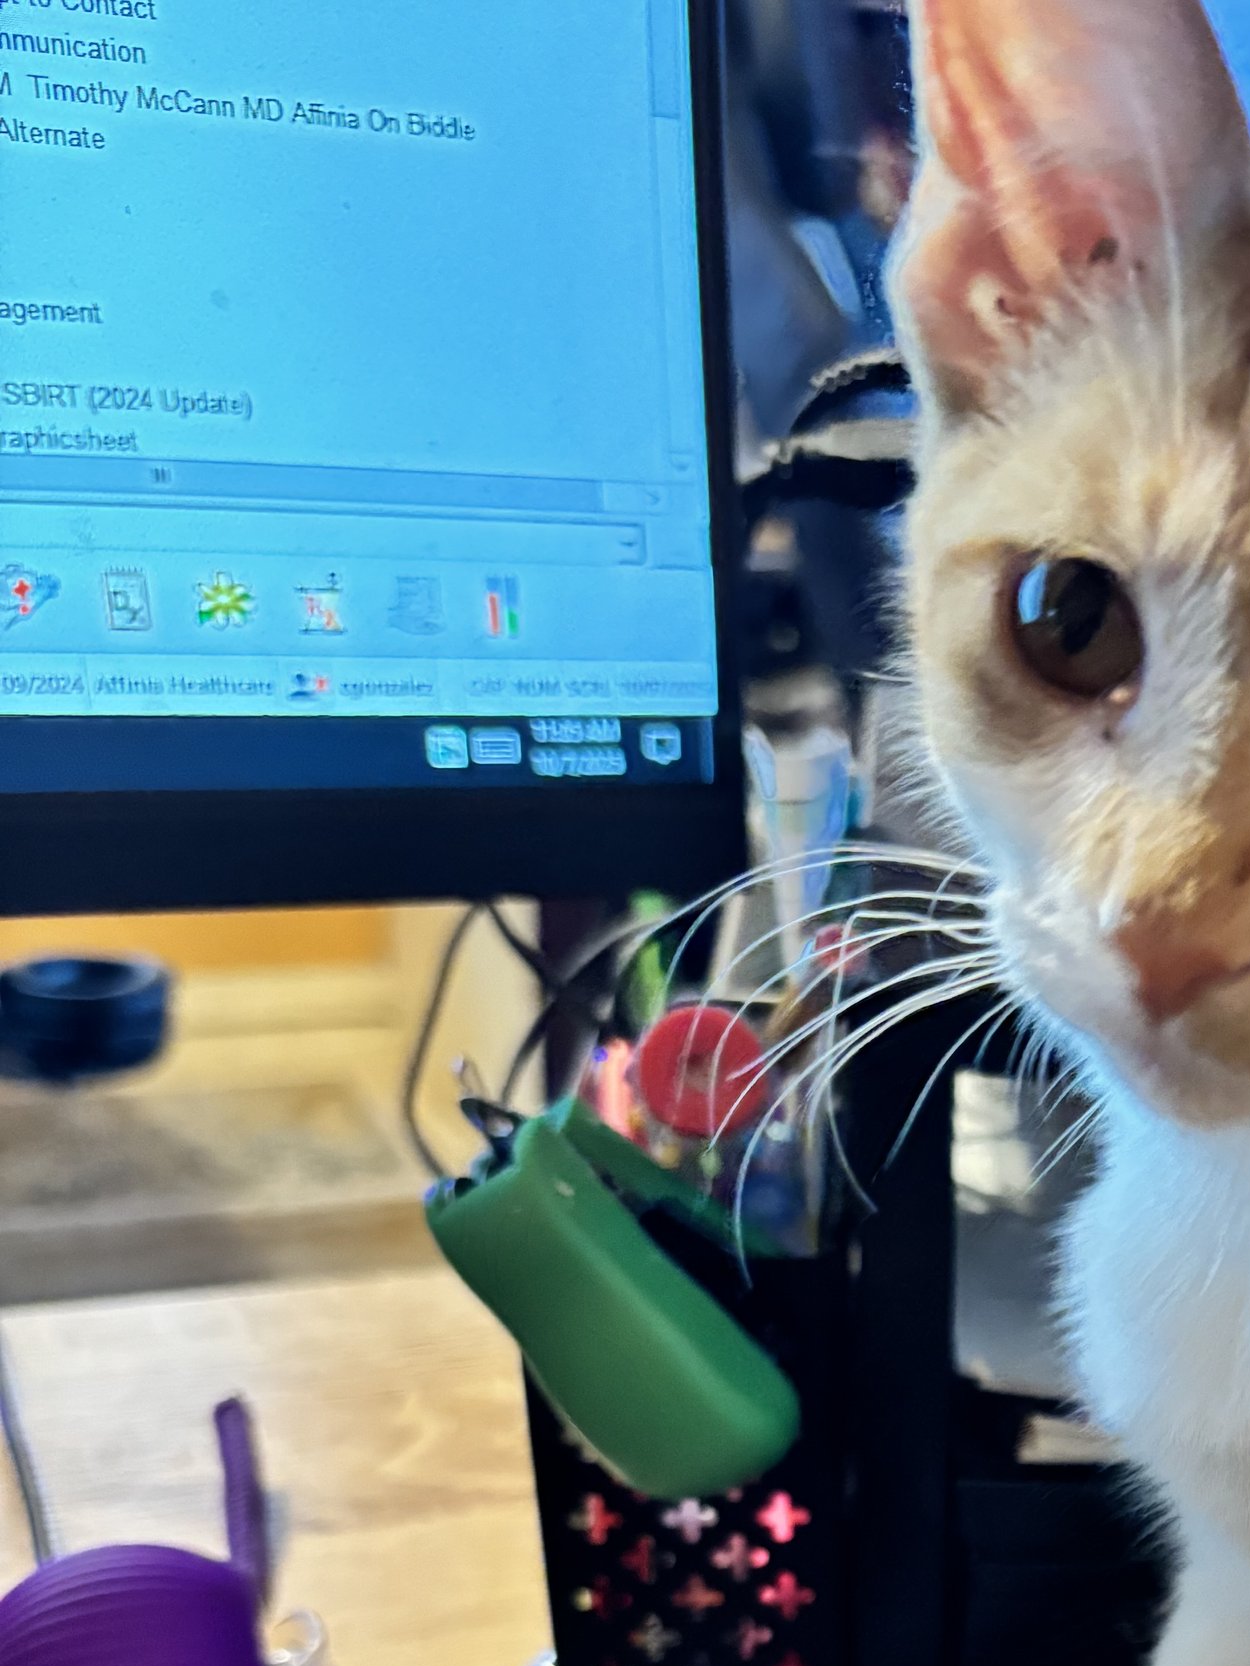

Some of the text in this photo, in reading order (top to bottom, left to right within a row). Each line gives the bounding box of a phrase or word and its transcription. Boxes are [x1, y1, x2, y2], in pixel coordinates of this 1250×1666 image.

[26, 74, 128, 112] Timothy
[136, 85, 235, 118] McCann
[243, 97, 283, 121] MD
[291, 102, 360, 129] Affinia
[368, 108, 400, 133] On
[407, 112, 476, 140] Biddle
[0, 117, 105, 149] Alternate
[0, 302, 103, 325] agement
[3, 382, 252, 420] SBIRT (2024 Update)
